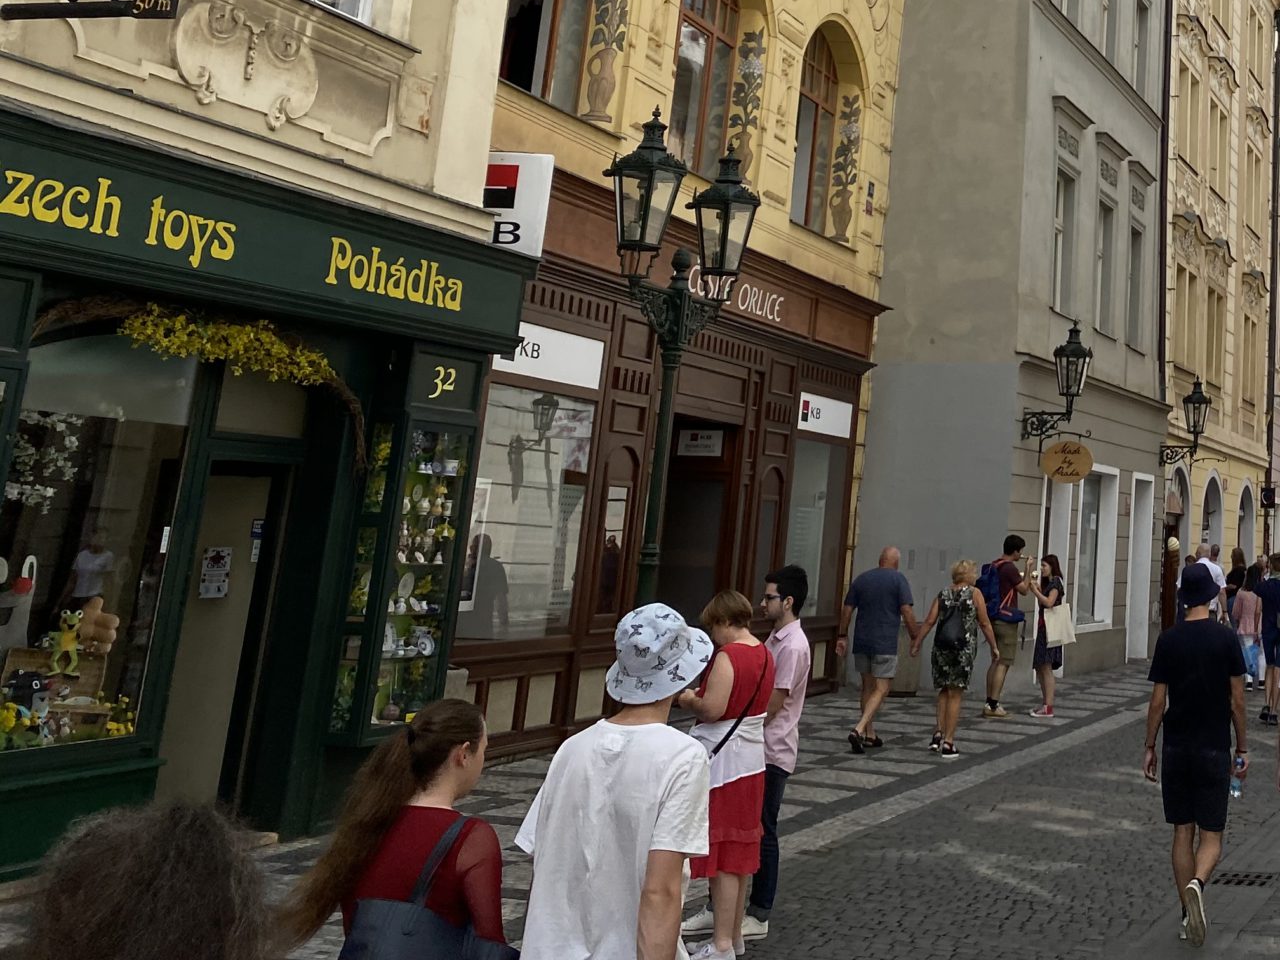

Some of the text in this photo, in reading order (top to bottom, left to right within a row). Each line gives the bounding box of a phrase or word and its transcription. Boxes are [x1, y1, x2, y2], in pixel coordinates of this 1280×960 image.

[156, 0, 171, 11] m
[0, 170, 236, 269] zech toys
[491, 221, 521, 245] B
[324, 236, 463, 312] Pohádka
[738, 283, 785, 322] ORLICE
[519, 341, 541, 359] KB
[428, 365, 457, 399] 32
[810, 406, 821, 420] KB
[1051, 466, 1081, 478] Praha
